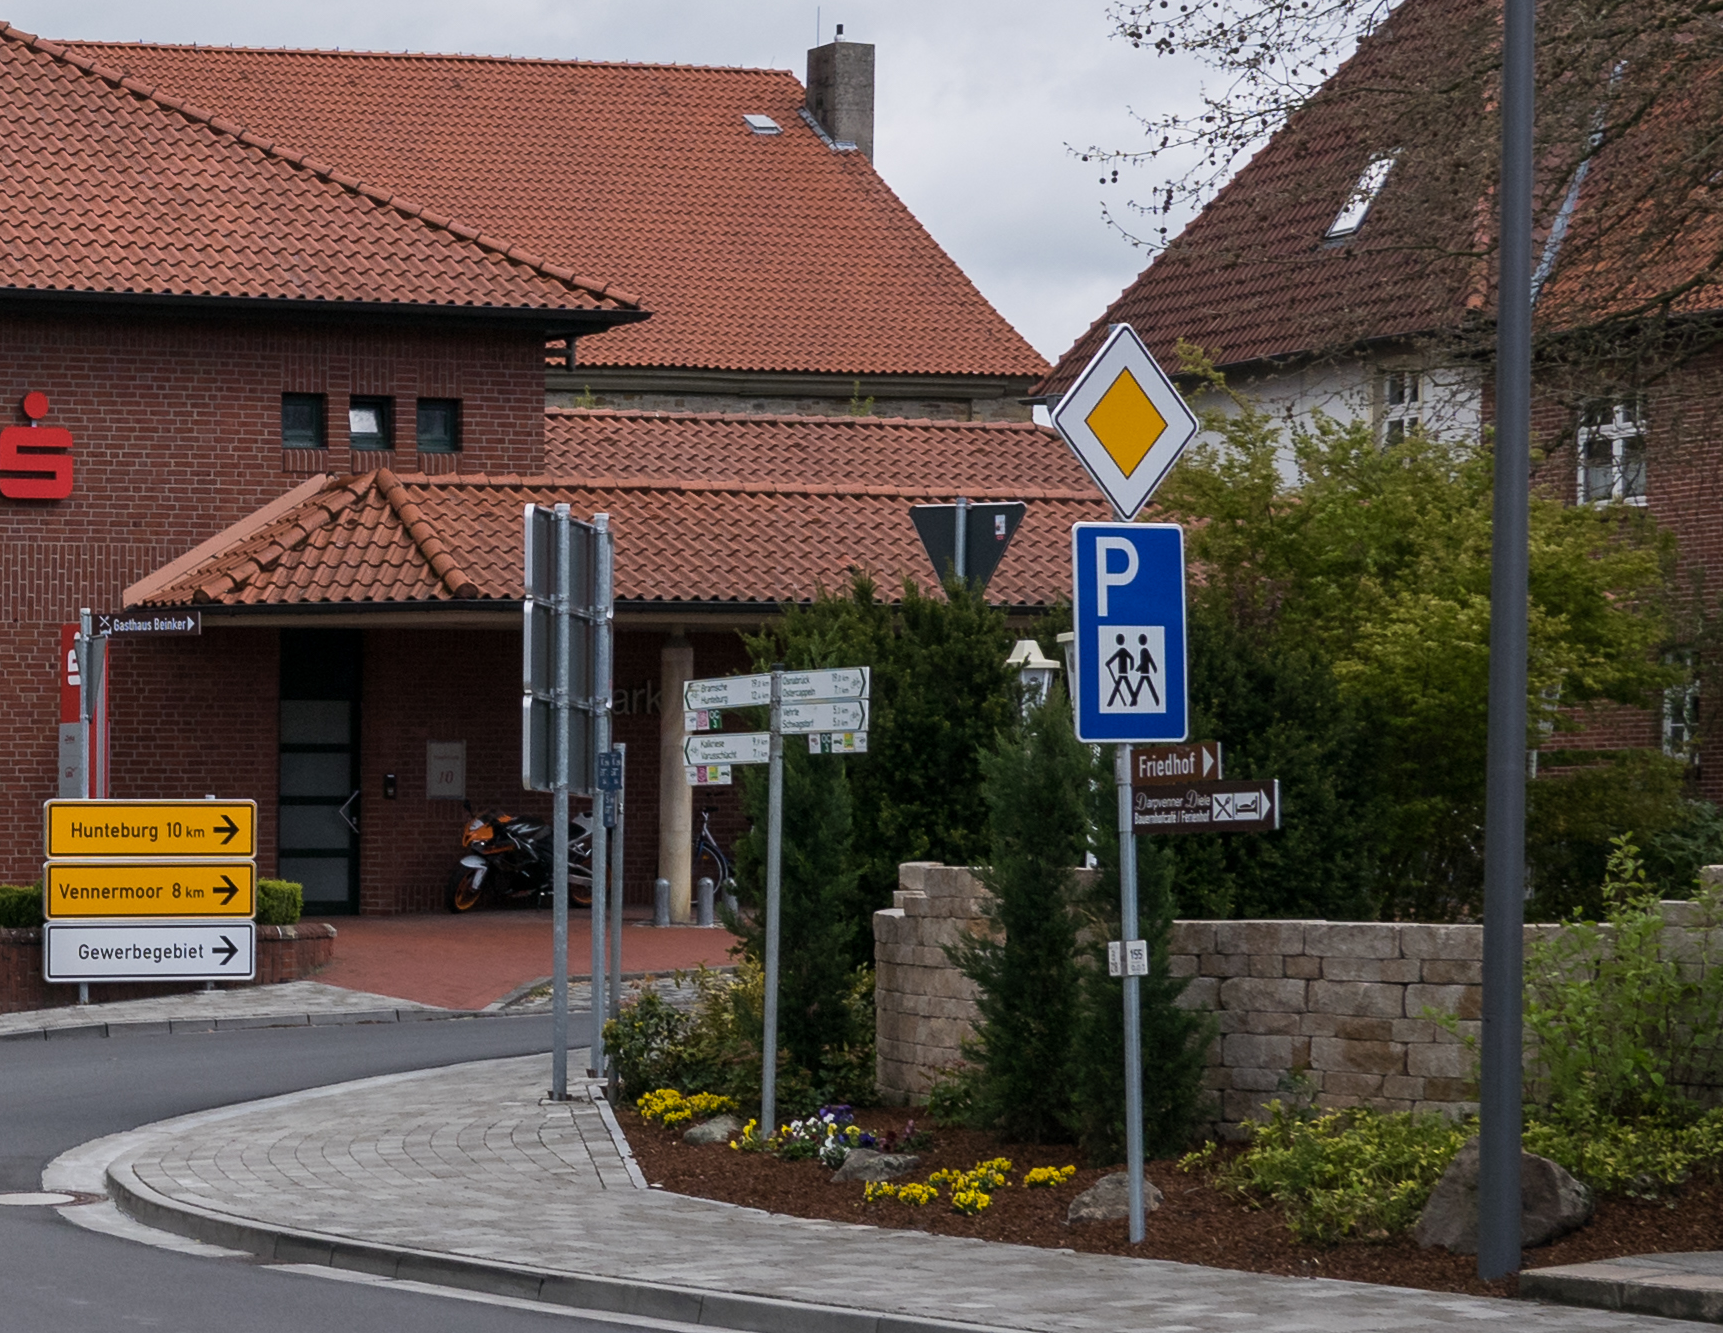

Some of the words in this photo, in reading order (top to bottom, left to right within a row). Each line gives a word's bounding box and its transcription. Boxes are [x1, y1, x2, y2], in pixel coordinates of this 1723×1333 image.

[1095, 536, 1140, 617] P
[113, 618, 152, 631] Gasthaus
[153, 617, 187, 631] Beinker
[701, 682, 728, 694] Bramsche
[701, 694, 728, 705] Hunteburg
[1139, 751, 1196, 778] Friedhof
[1134, 792, 1184, 811] Darpvenner
[1185, 789, 1211, 808] Diele
[1181, 809, 1211, 823] Ferienhof
[71, 822, 158, 842] Hunteburg
[167, 822, 182, 838] 10
[186, 826, 205, 838] km
[59, 883, 163, 899] Vennermoor
[172, 882, 182, 899] 8
[186, 886, 204, 898] km
[78, 943, 204, 963] Gewerbegebiet
